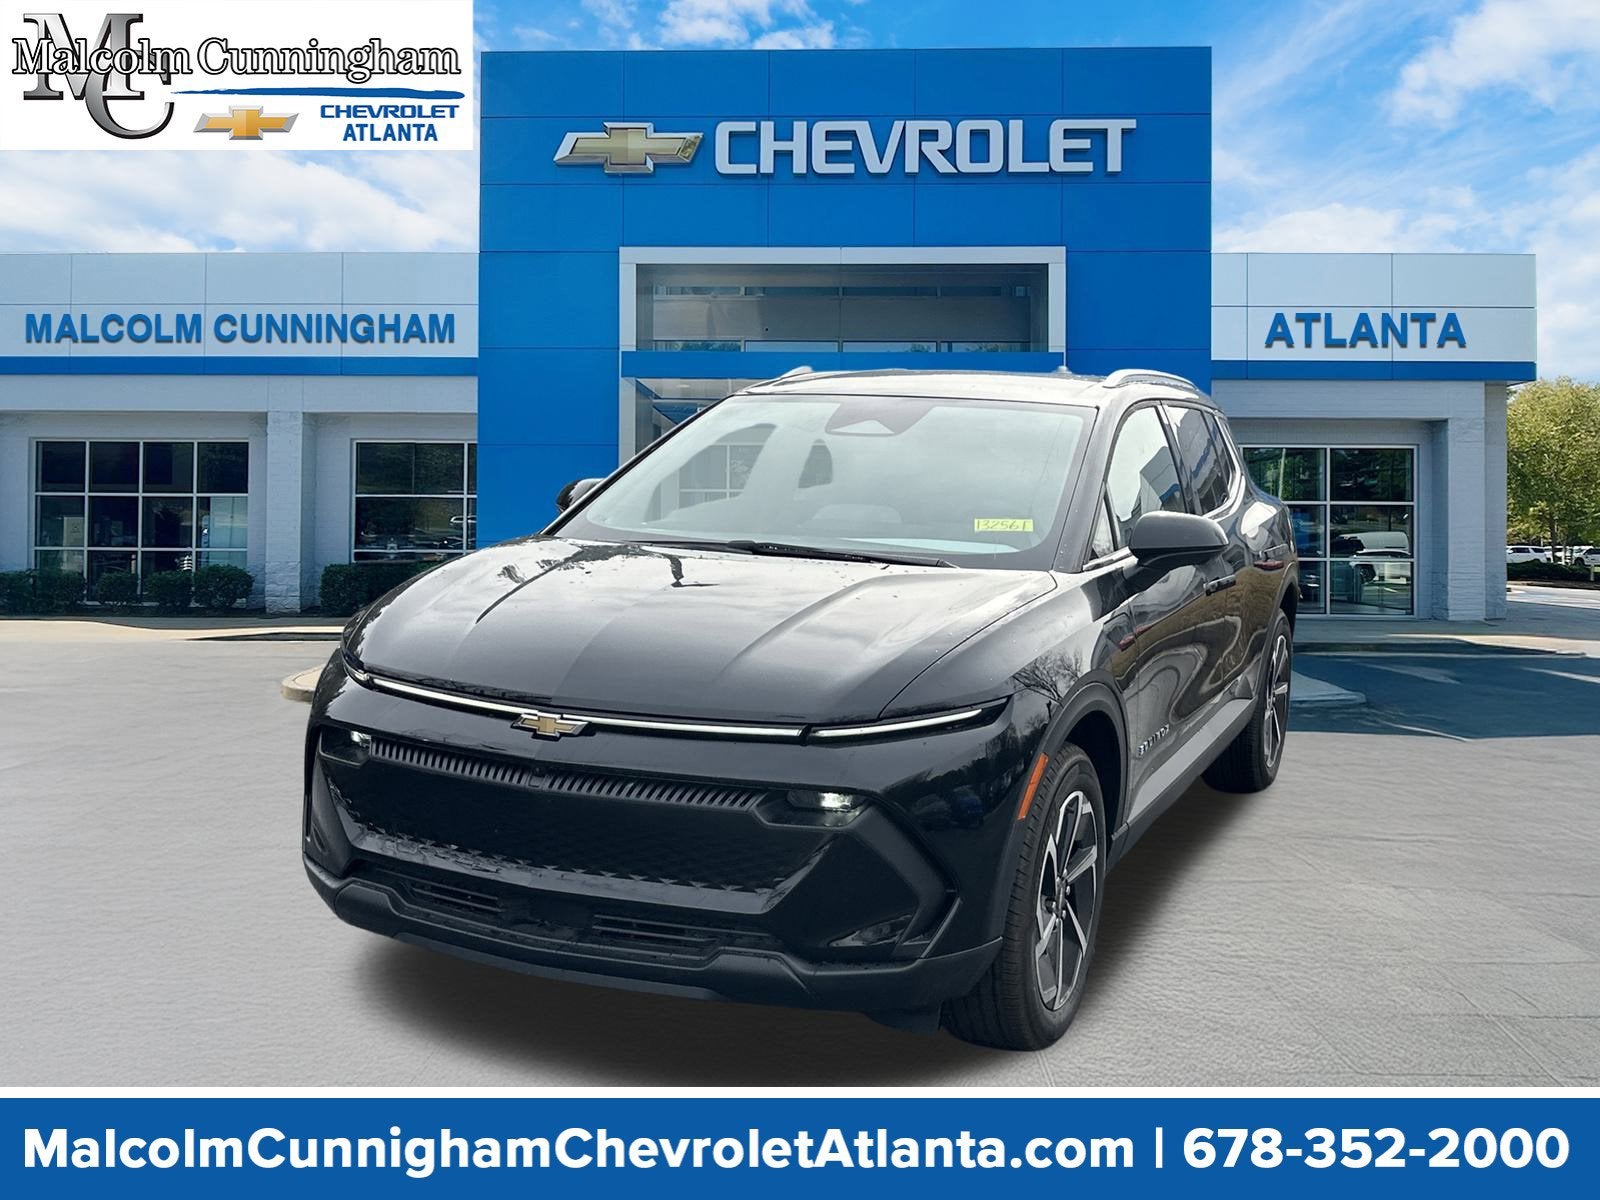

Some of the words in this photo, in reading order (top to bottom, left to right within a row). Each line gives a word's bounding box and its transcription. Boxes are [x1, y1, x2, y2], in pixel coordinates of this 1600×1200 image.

[715, 118, 1137, 174] CHEVROLET
[25, 313, 203, 344] MALCOLM
[213, 312, 456, 344] CUNNINGHAM
[1264, 312, 1467, 348] ATLANTA
